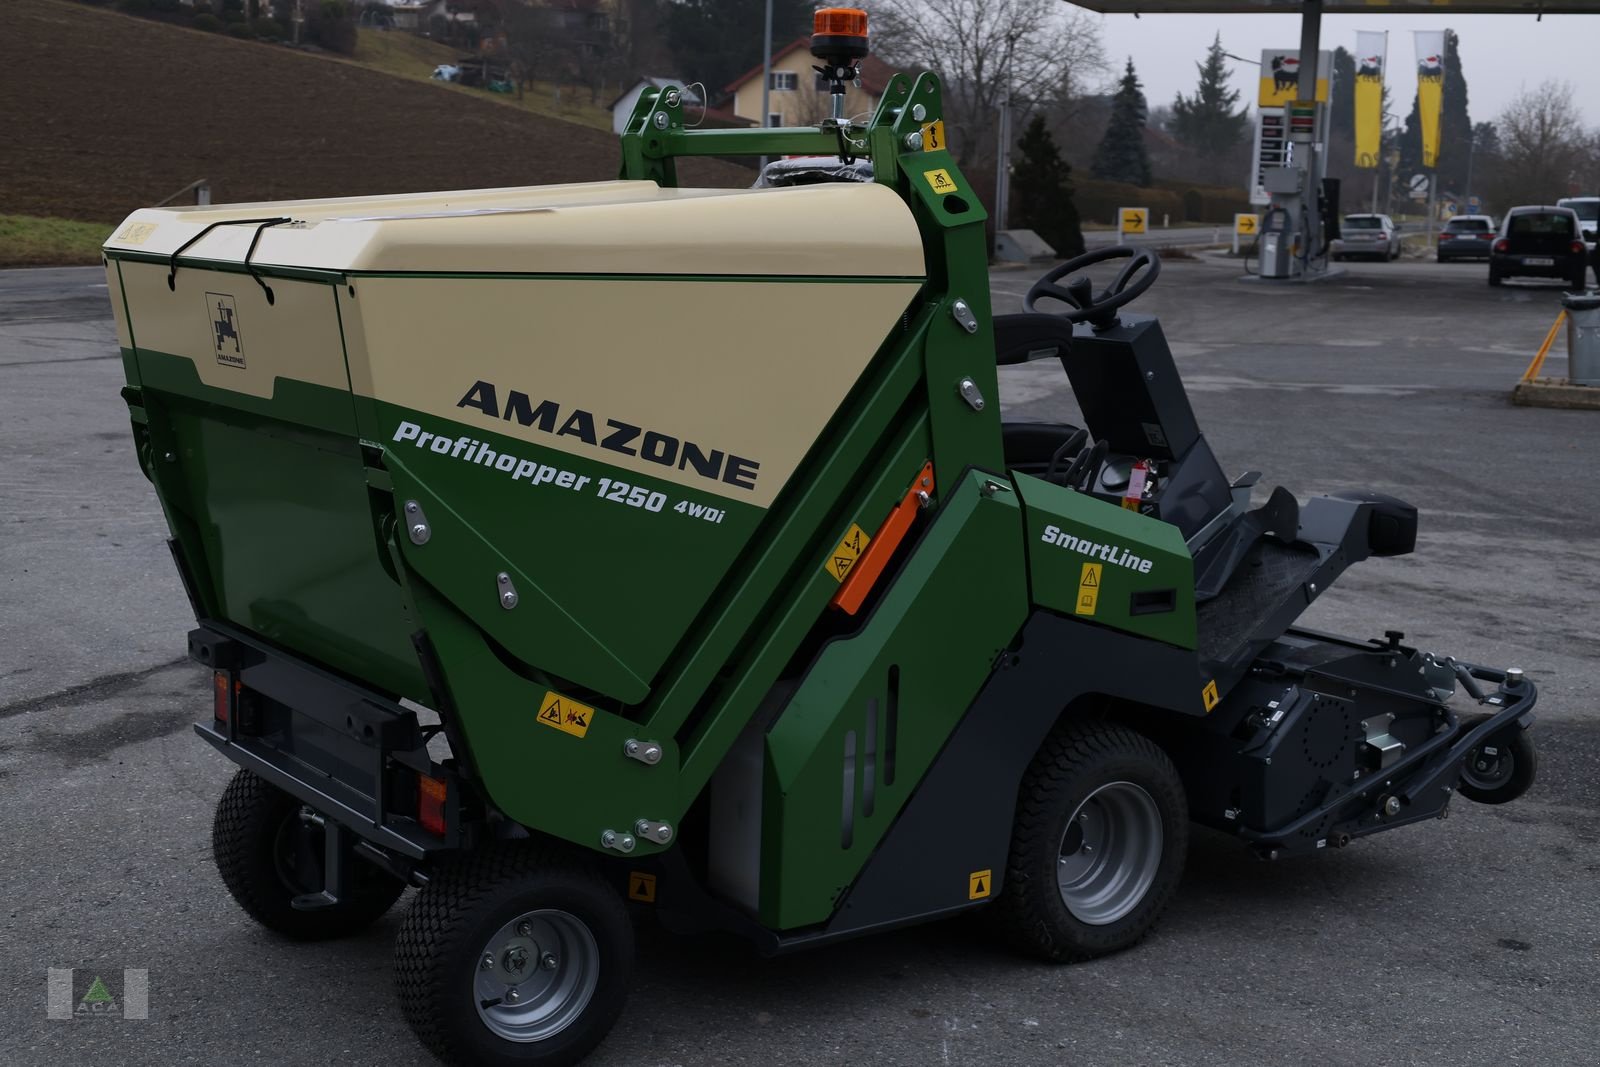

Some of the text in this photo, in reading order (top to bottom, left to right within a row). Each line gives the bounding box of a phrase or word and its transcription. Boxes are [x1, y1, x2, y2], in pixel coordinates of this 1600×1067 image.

[217, 354, 244, 365] AMAZONE
[392, 420, 726, 524] Profihopper 1250 4WDi
[456, 380, 760, 490] AMAZONE
[1041, 524, 1153, 574] SmartLine
